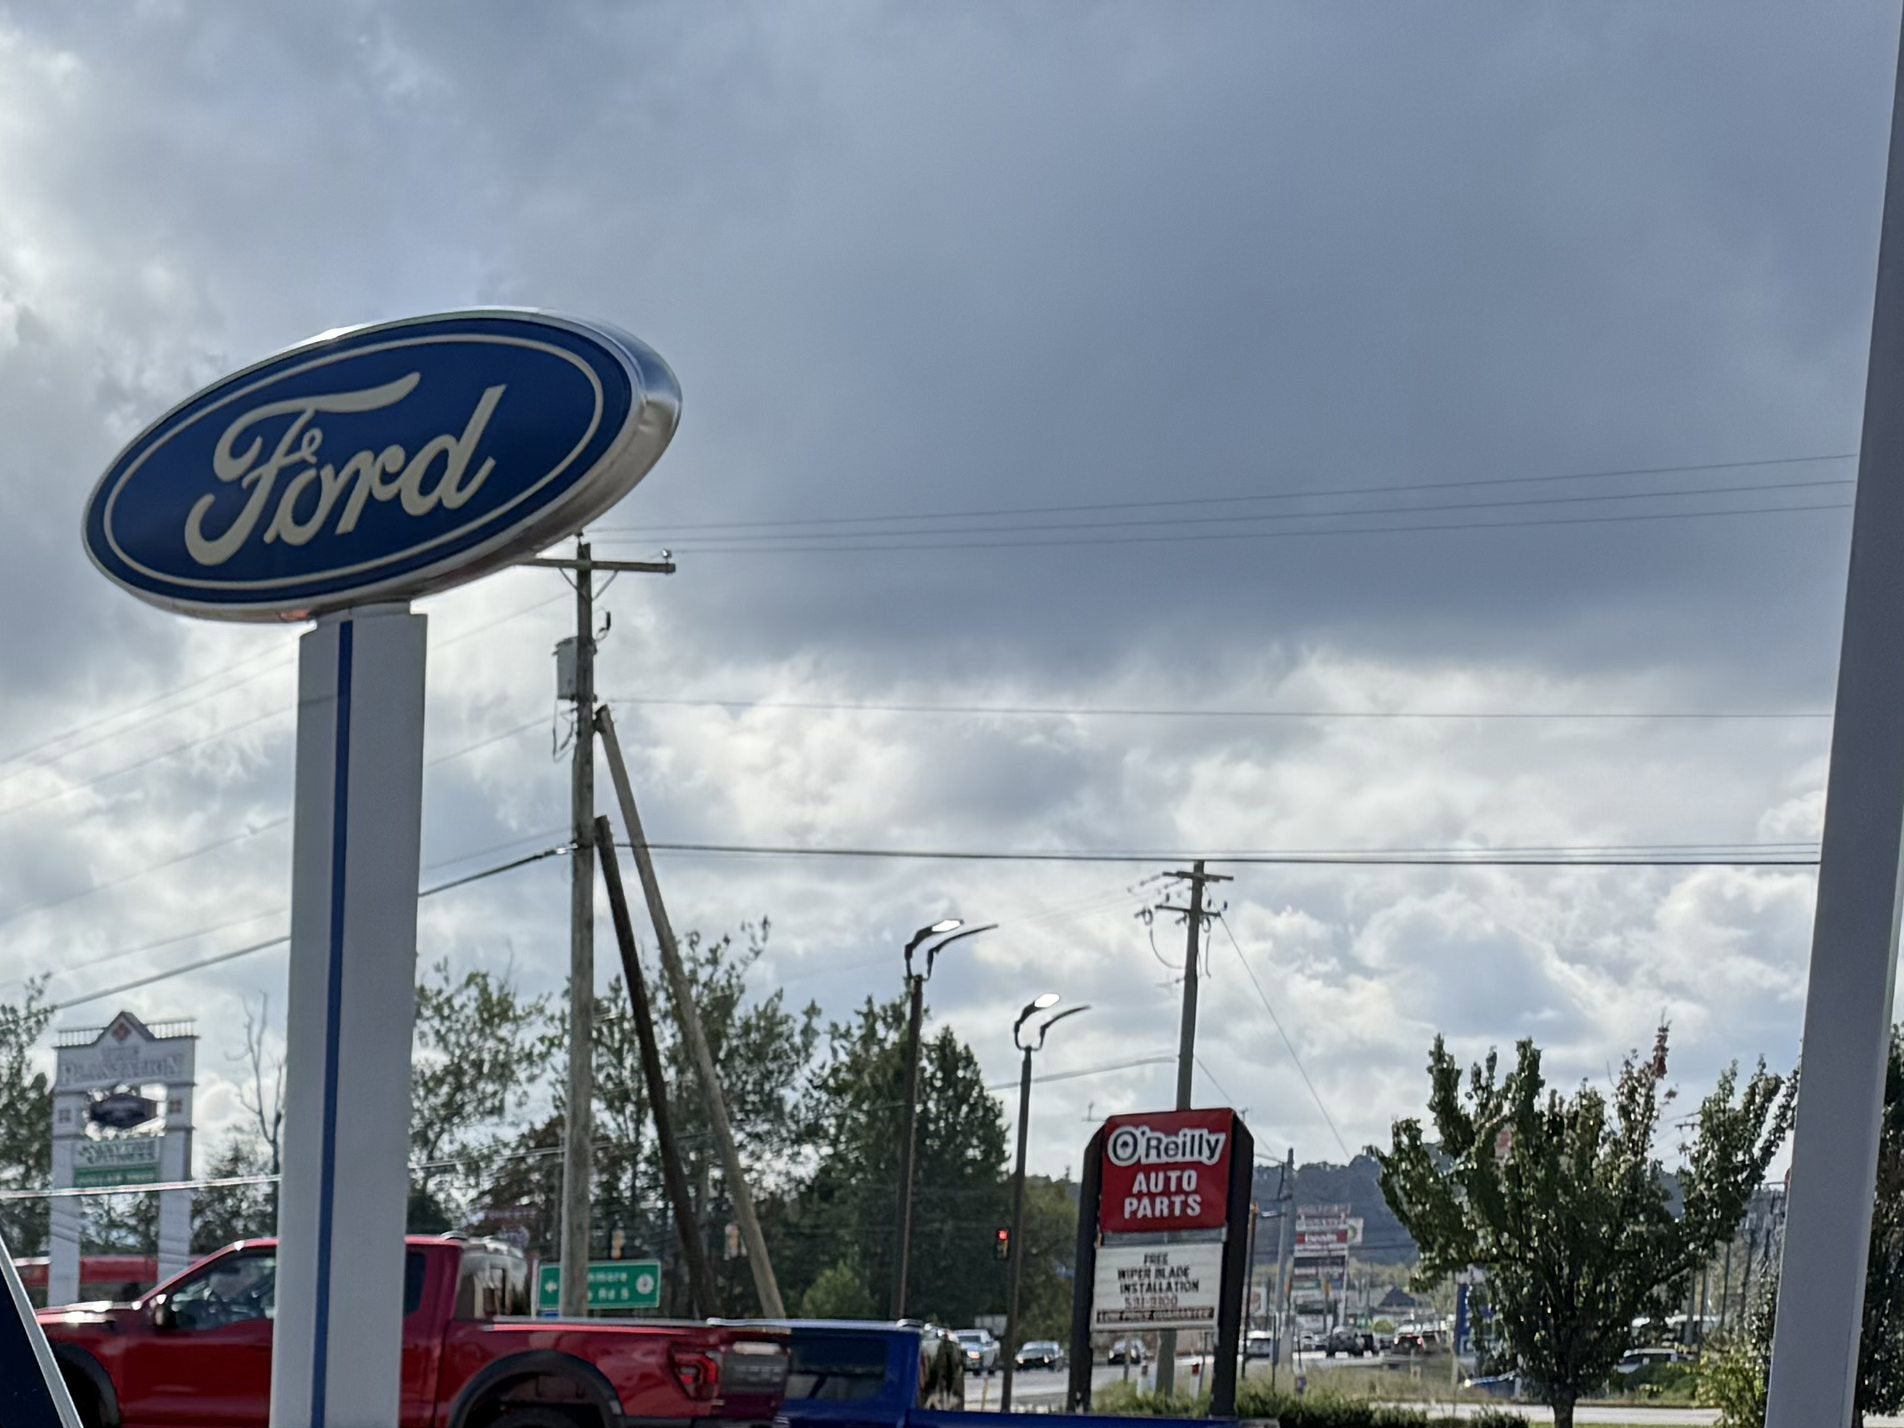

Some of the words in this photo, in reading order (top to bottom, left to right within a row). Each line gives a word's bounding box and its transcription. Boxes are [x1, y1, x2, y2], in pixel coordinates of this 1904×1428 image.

[184, 371, 508, 565] Ford
[1110, 1126, 1224, 1164] O'Reilly
[1132, 1169, 1198, 1194] AUTO
[1123, 1194, 1202, 1219] PARTS
[1143, 1252, 1169, 1265] FREE
[1117, 1267, 1152, 1281] WIPER
[1154, 1264, 1190, 1280] BLADE
[1119, 1279, 1200, 1295] INSTALLATION
